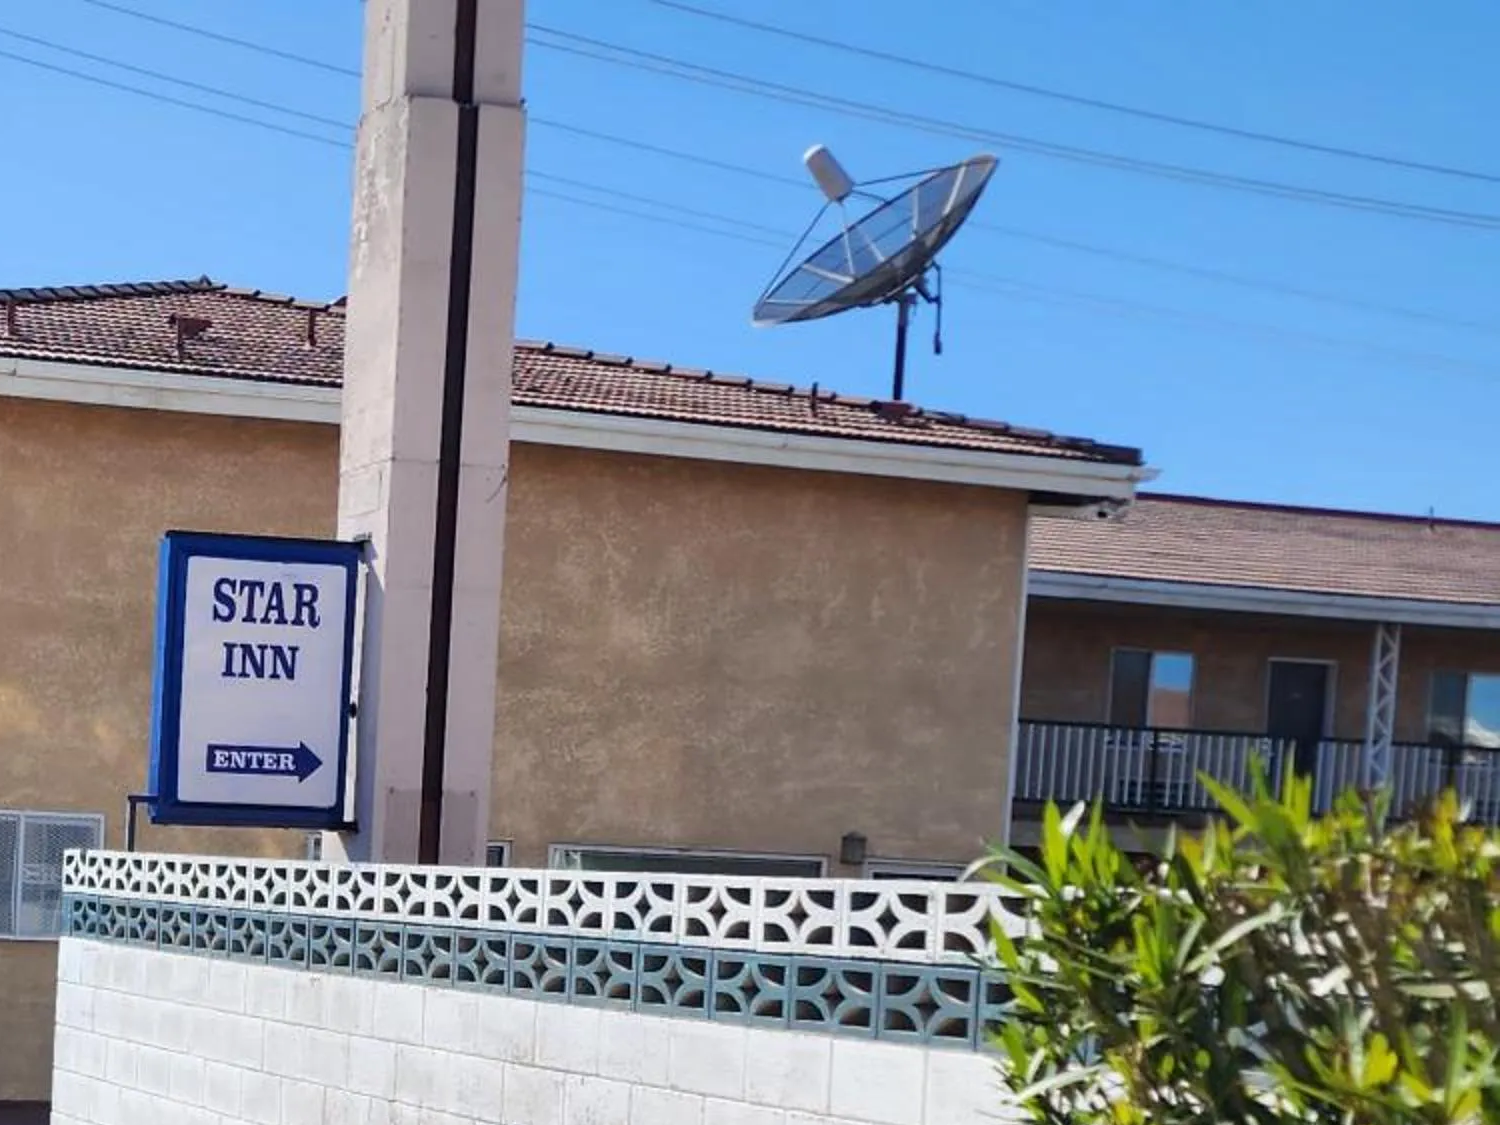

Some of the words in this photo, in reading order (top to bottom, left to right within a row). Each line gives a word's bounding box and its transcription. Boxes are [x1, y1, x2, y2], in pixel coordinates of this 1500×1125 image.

[212, 577, 320, 628] STAR
[221, 642, 299, 680] INN
[213, 750, 296, 770] ENTER
